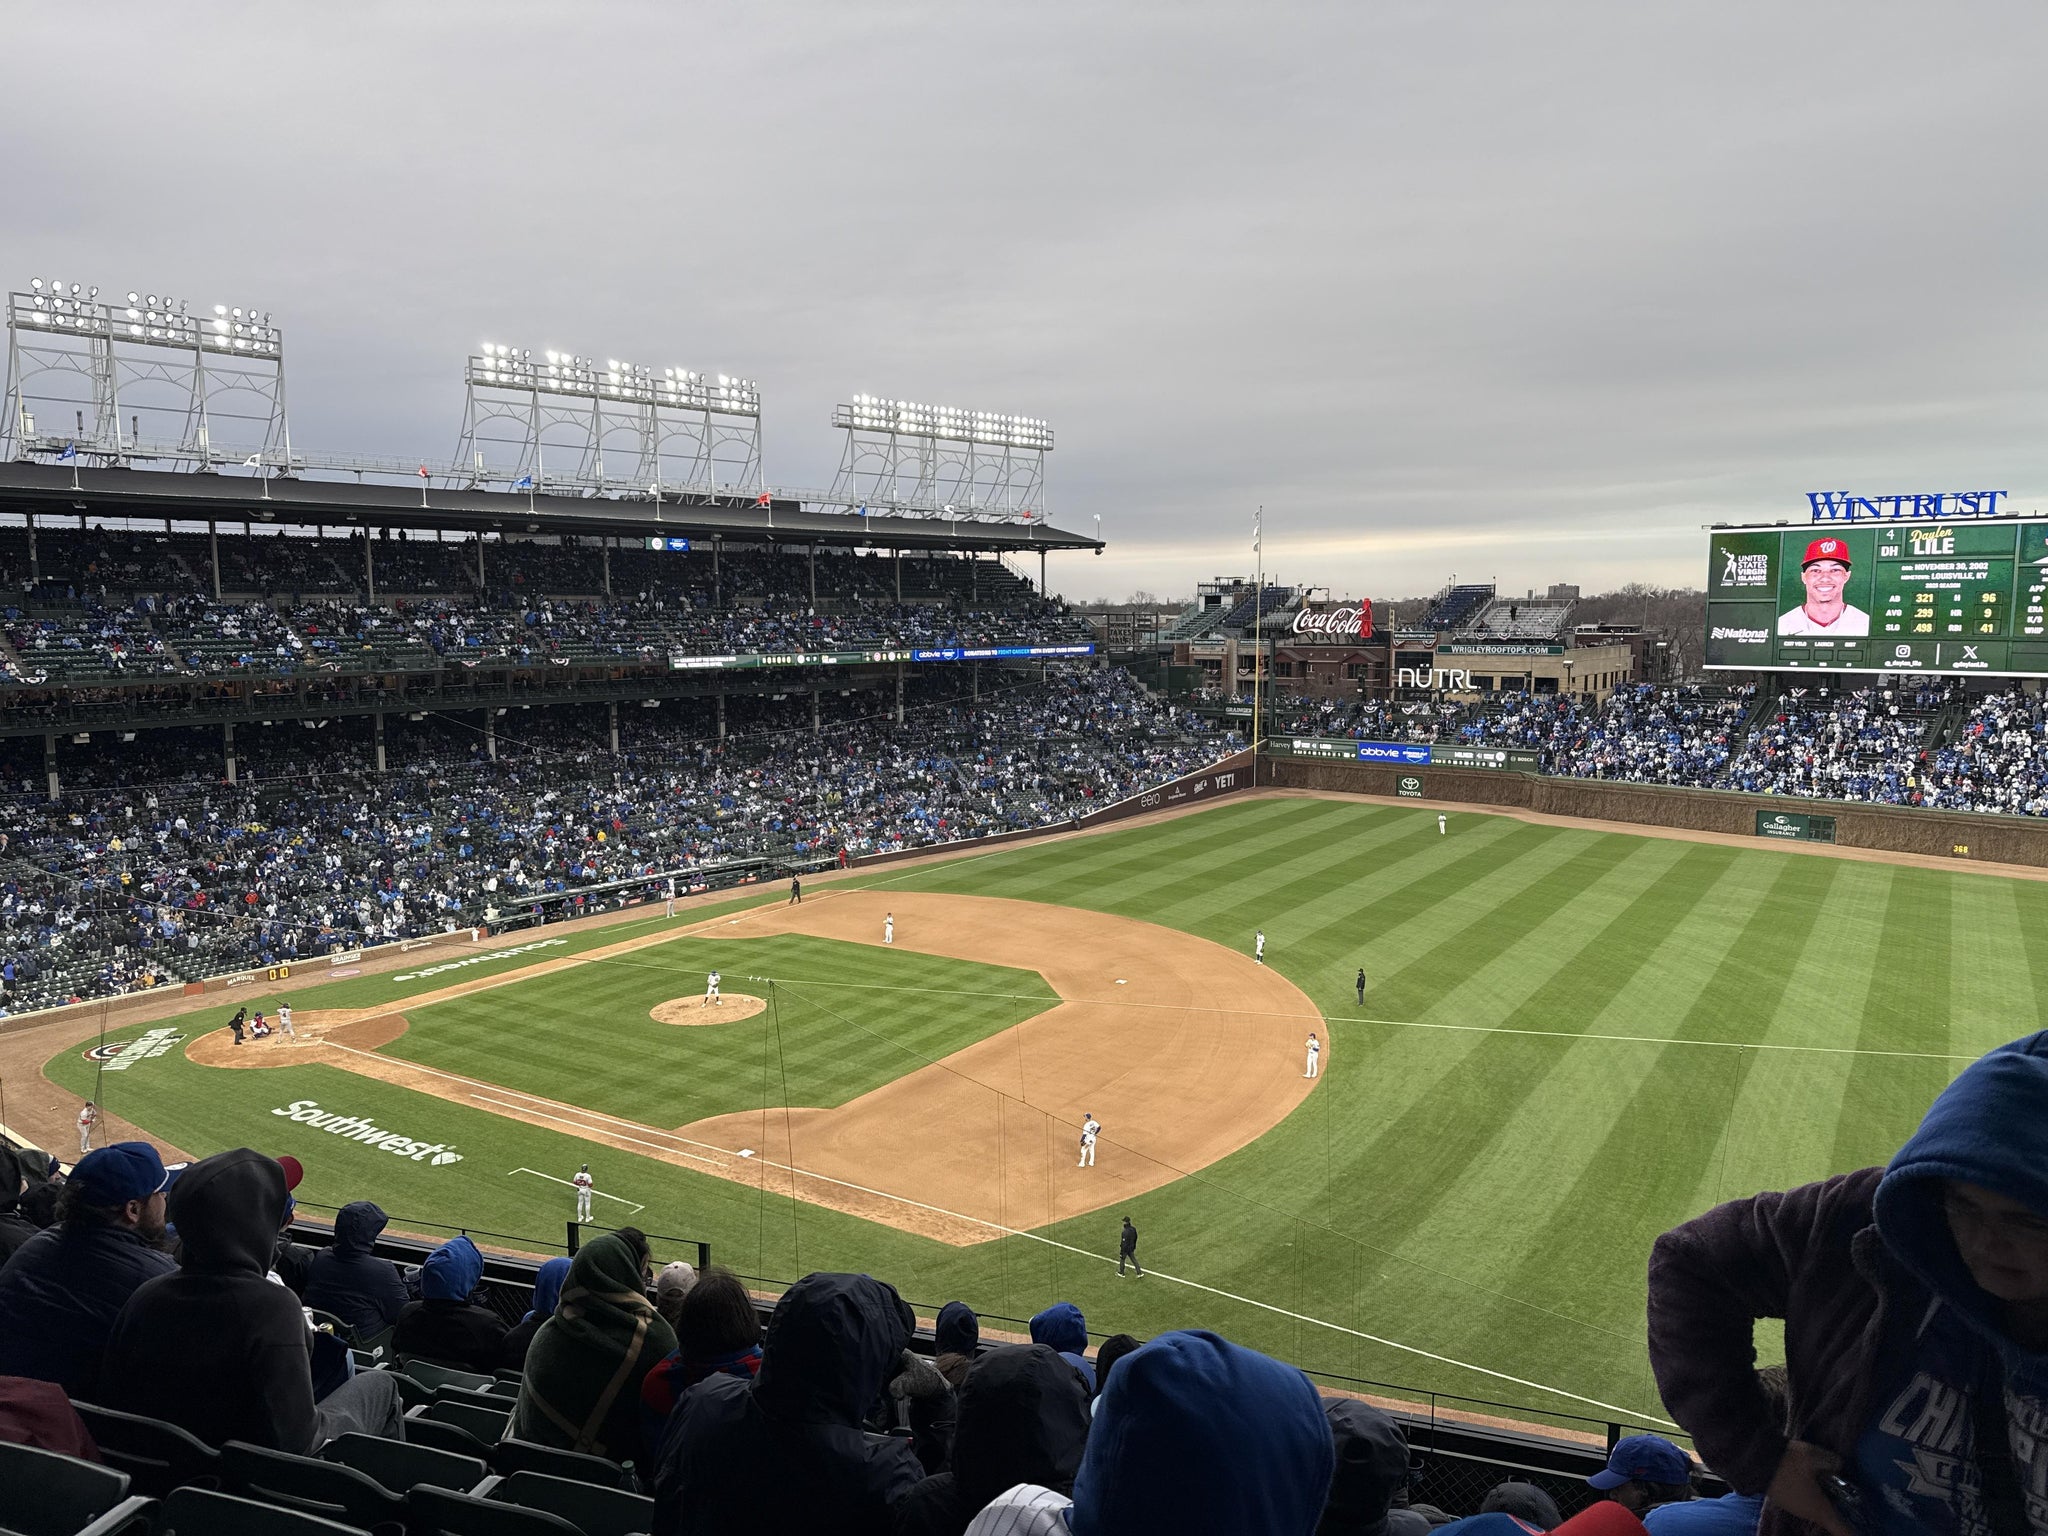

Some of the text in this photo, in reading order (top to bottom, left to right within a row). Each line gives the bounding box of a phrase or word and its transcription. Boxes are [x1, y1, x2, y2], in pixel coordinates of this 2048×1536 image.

[1806, 490, 2007, 520] WINTRUST
[1886, 529, 1894, 540] 4
[1909, 525, 1953, 542] Daylen
[1881, 546, 1898, 557] DH
[1914, 538, 1955, 555] LILE
[1914, 563, 1954, 571] NOVEMBER
[1916, 593, 1934, 603] 321
[1953, 594, 1961, 602] H
[1982, 593, 1997, 603] 96
[1885, 608, 1992, 618] AVG .299 HR 9
[1292, 607, 1365, 634] Coca-Cola
[1913, 623, 1932, 632] .498
[1948, 624, 1962, 632] RBI
[1980, 623, 1994, 633] 41
[1451, 645, 1548, 654] WRIGLEYROOFTOPS.COM
[1270, 741, 1291, 749] Harvey
[1360, 747, 1399, 757] abbvie
[1215, 773, 1235, 789] YETI
[1140, 792, 1161, 808] eero
[1762, 821, 1801, 832] Gallagher
[1767, 829, 1796, 837] INSURANCE
[1953, 844, 1968, 854] 368
[331, 952, 360, 963] GRAINGER
[227, 974, 255, 986] MARQUEE
[271, 1100, 446, 1161] Southwest
